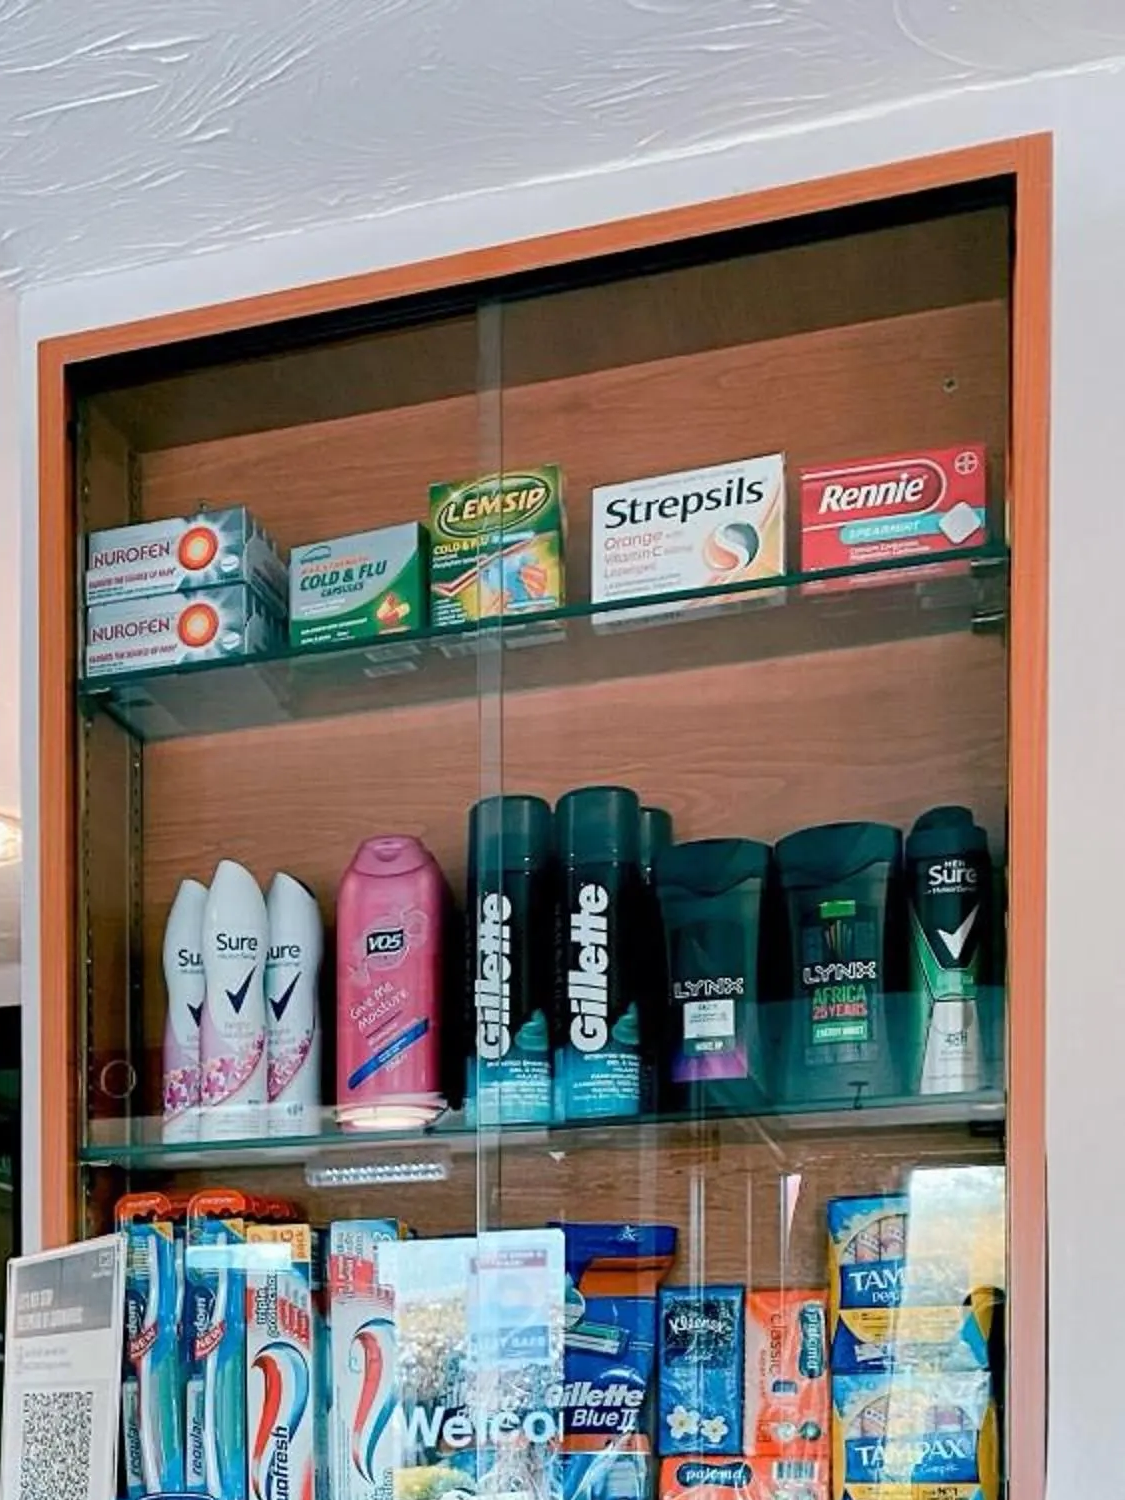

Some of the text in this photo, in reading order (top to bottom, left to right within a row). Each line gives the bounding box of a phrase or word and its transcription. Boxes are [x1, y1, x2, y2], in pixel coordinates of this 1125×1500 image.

[446, 486, 547, 524] LEMSIP
[604, 476, 765, 529] Strepsils
[818, 472, 927, 514] Rennie
[433, 540, 461, 555] COLD
[604, 530, 664, 551] Orange
[93, 541, 171, 569] NUROFEN
[299, 571, 340, 592] COLD
[342, 567, 355, 583] &
[358, 559, 388, 580] FLU
[91, 617, 171, 643] NUROFEN
[928, 864, 977, 885] Sure
[215, 933, 259, 952] Sure
[266, 944, 301, 961] ure
[368, 934, 402, 952] VO5
[177, 948, 204, 968] Su
[568, 883, 610, 1053] Gillette
[474, 892, 513, 1061] Gillette
[803, 960, 877, 985] LYNX
[673, 976, 745, 999] LYNX
[812, 984, 868, 1005] AFRICA
[126, 1299, 138, 1337] dom
[193, 1296, 206, 1336] dom
[668, 1314, 727, 1335] Kleenex
[544, 1381, 645, 1409] Gillette
[571, 1408, 620, 1428] Blue
[189, 1417, 203, 1476] regular
